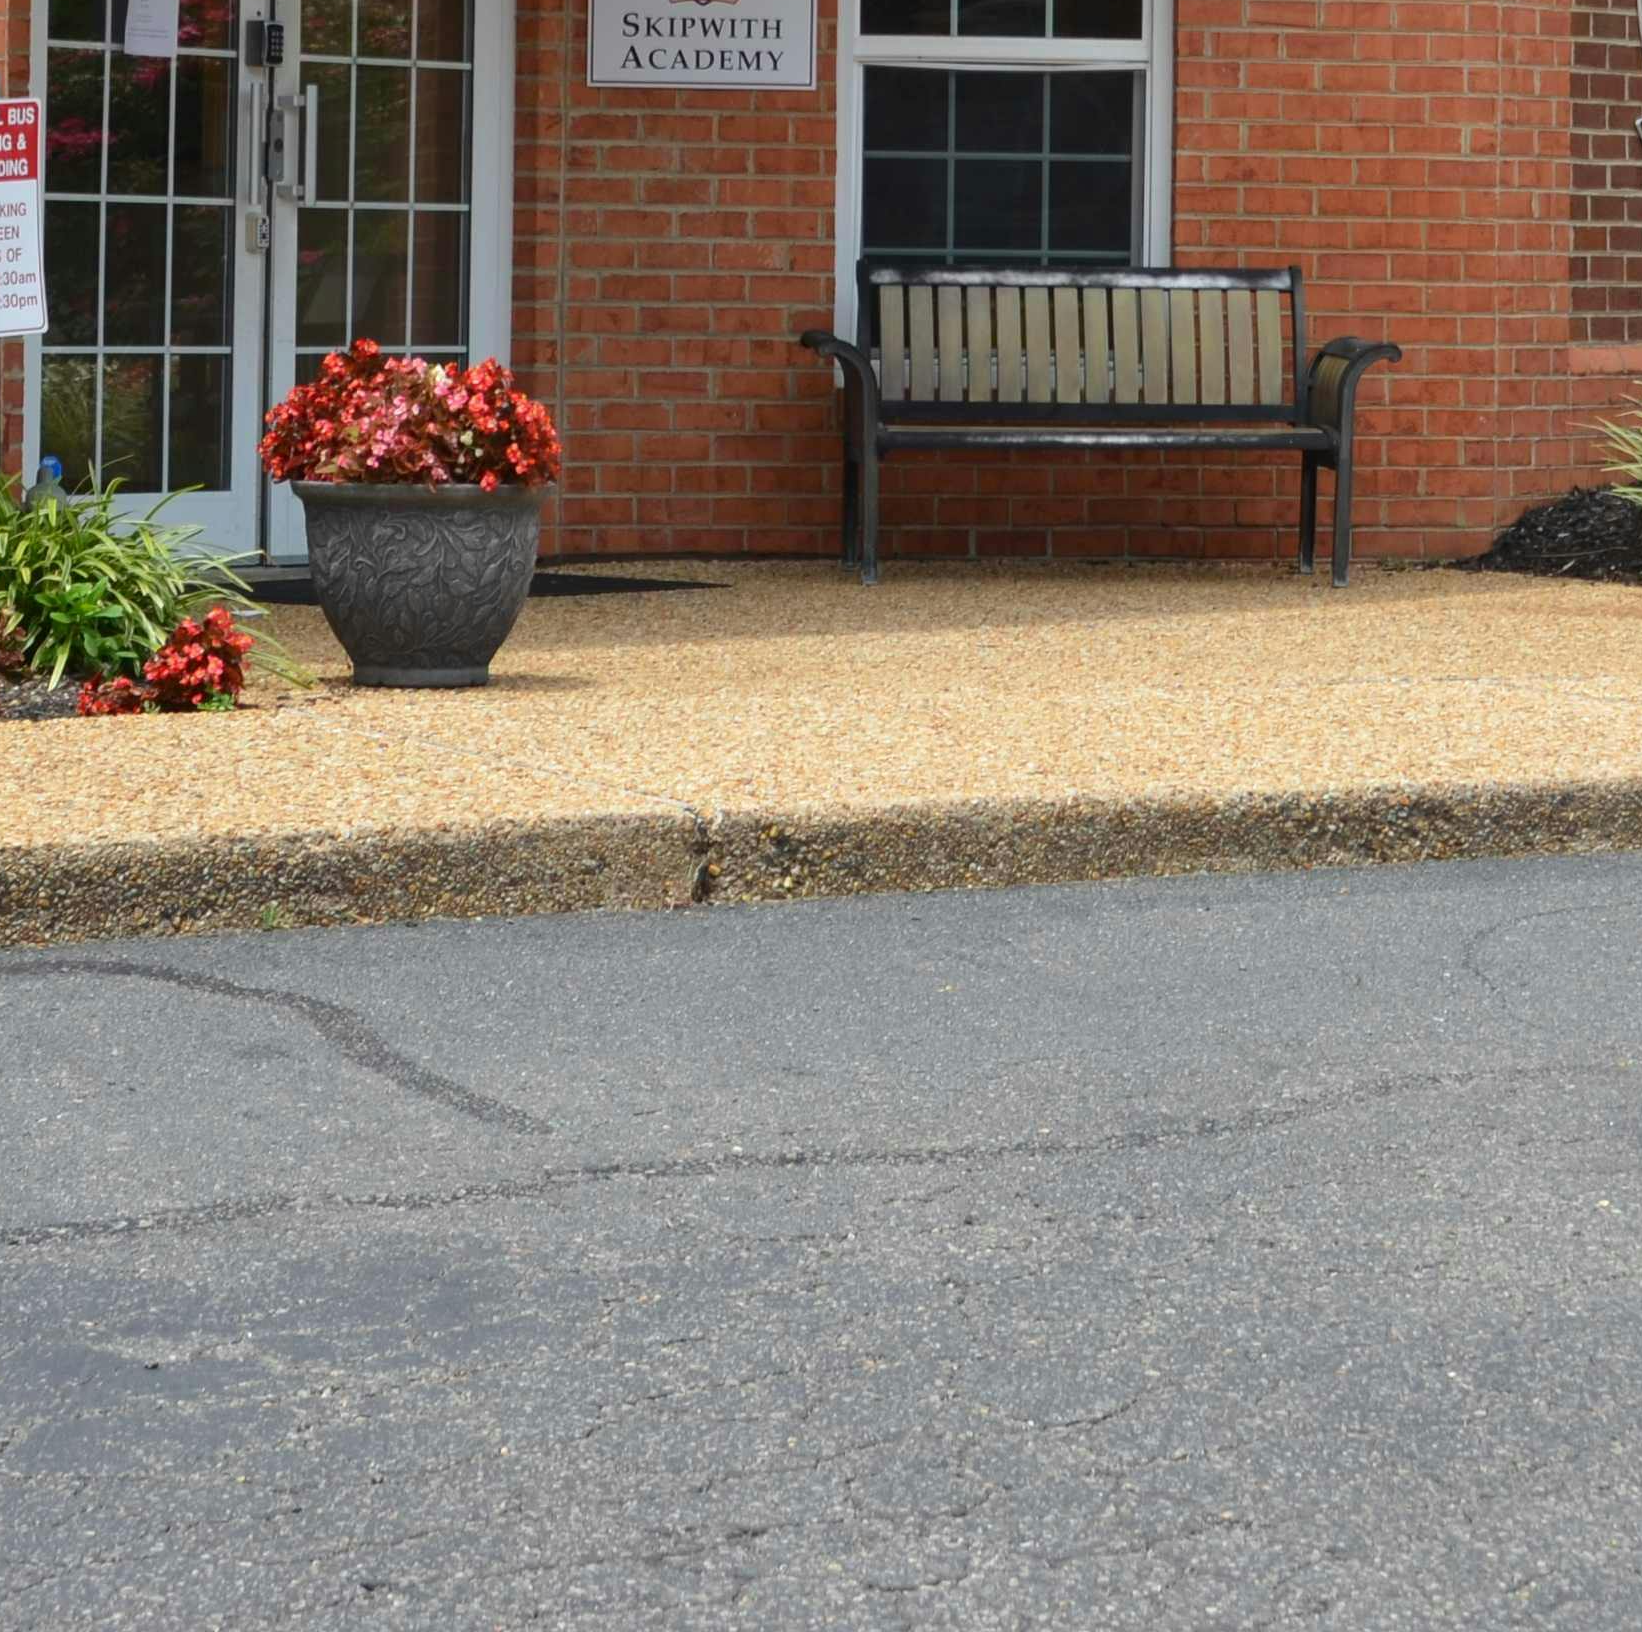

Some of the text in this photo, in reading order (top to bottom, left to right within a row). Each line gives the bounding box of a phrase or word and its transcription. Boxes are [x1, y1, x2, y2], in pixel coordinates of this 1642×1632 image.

[621, 12, 783, 40] SKIPWITH
[620, 44, 784, 72] ACADEMY
[8, 107, 34, 125] BUS
[17, 133, 26, 150] &
[6, 247, 22, 263] OF
